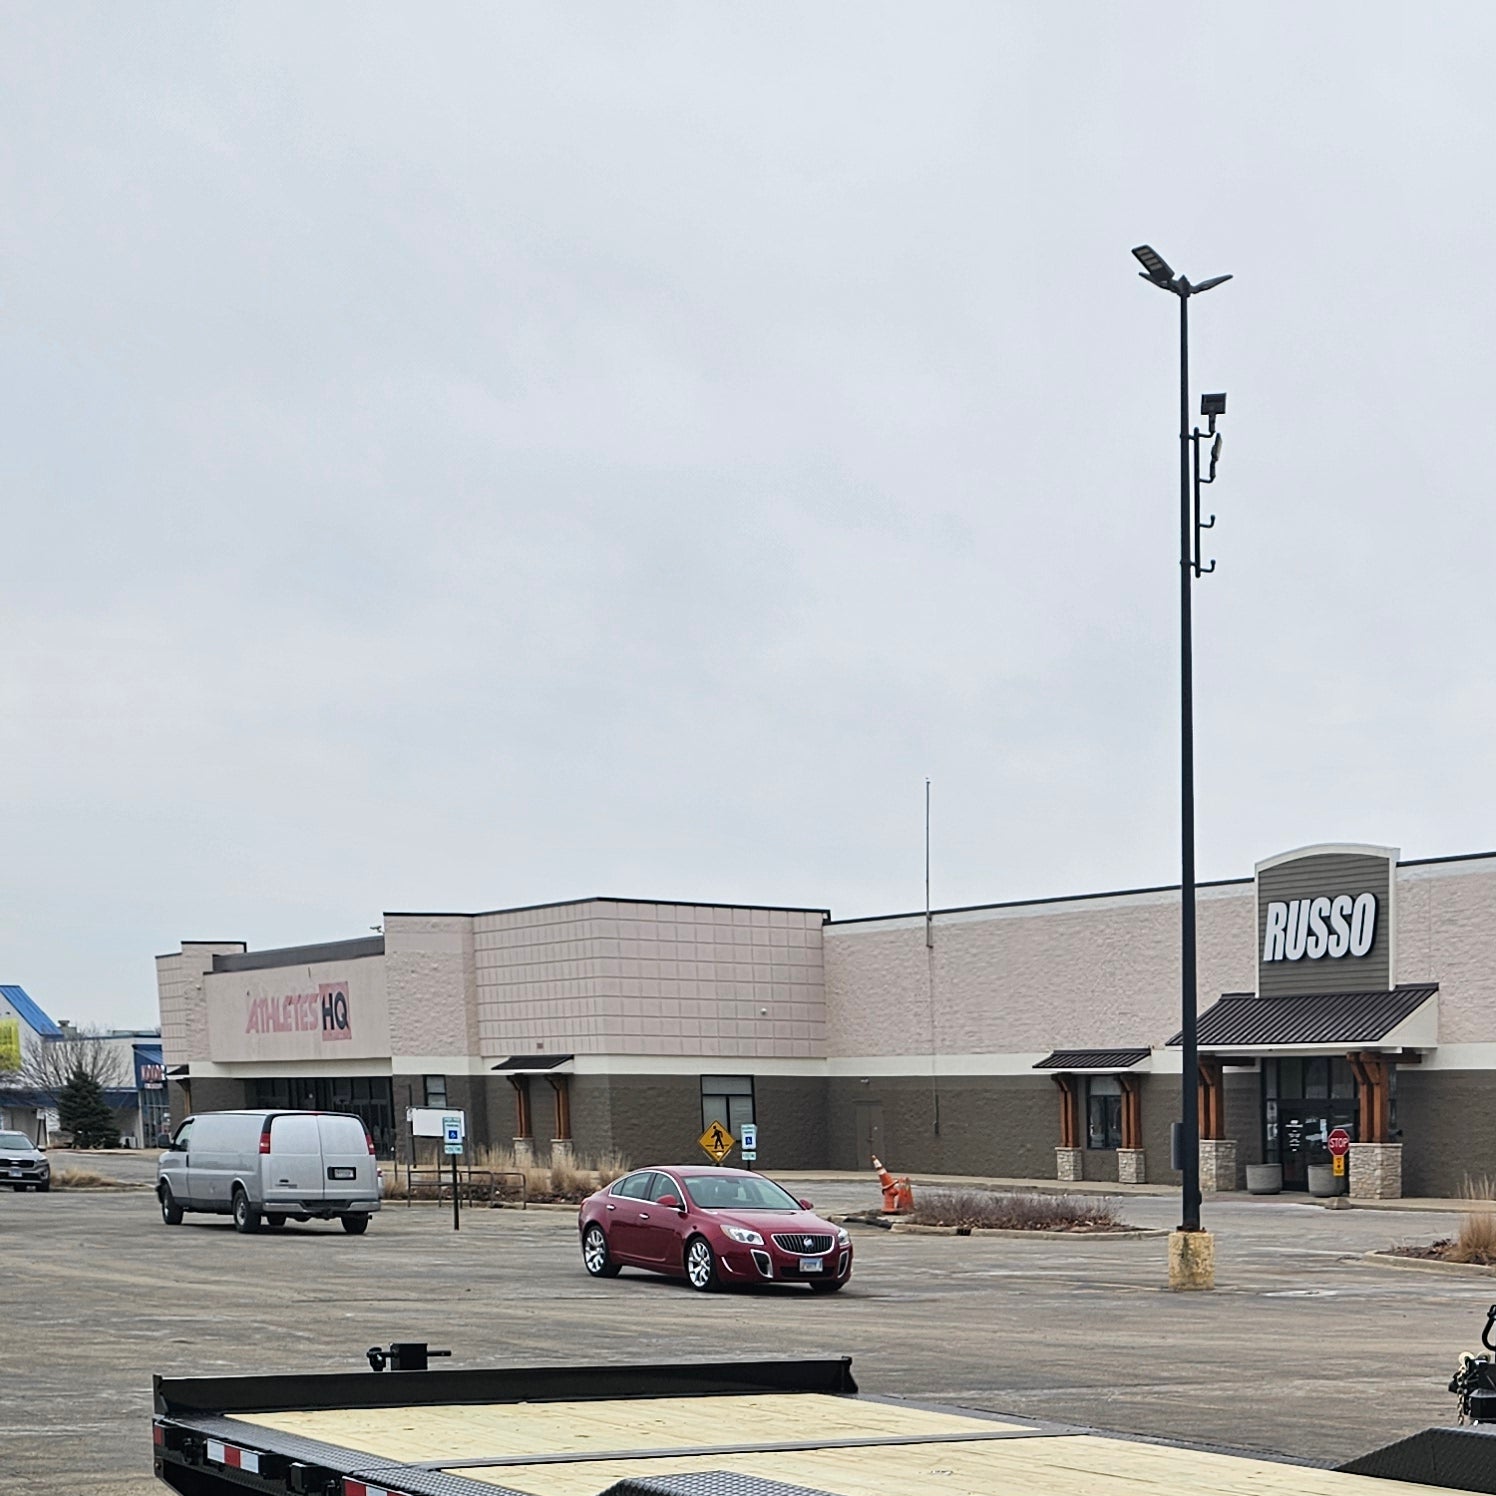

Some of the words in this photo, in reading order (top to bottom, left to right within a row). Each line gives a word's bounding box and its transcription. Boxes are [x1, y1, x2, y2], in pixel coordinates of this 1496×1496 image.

[1263, 892, 1376, 961] RUSSO
[245, 993, 319, 1034] ATHLETES
[322, 991, 350, 1030] HQ
[1329, 1137, 1349, 1148] STOP
